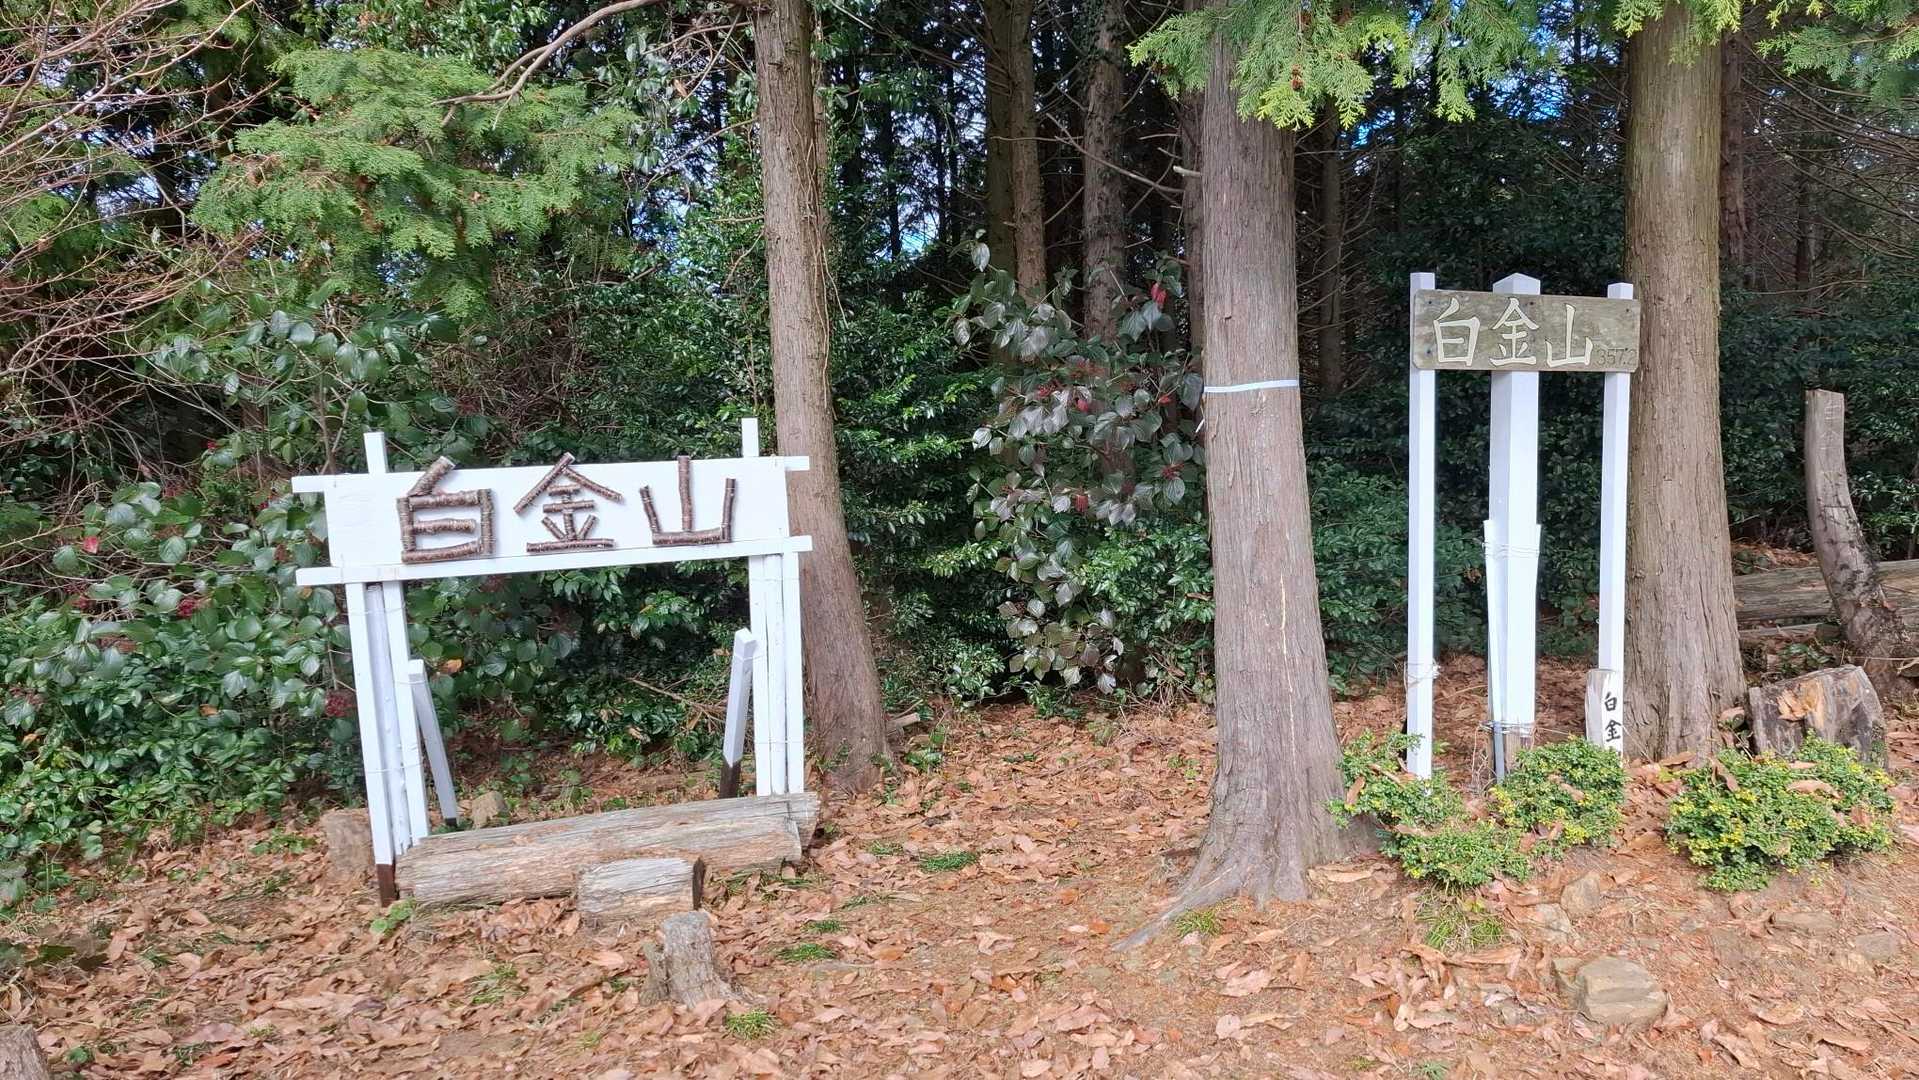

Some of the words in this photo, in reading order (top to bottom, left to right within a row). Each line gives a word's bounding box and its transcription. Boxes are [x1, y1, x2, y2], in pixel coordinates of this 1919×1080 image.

[1432, 297, 1594, 368] 白金山
[398, 451, 737, 563] 白金山
[1604, 692, 1623, 757] 白金
